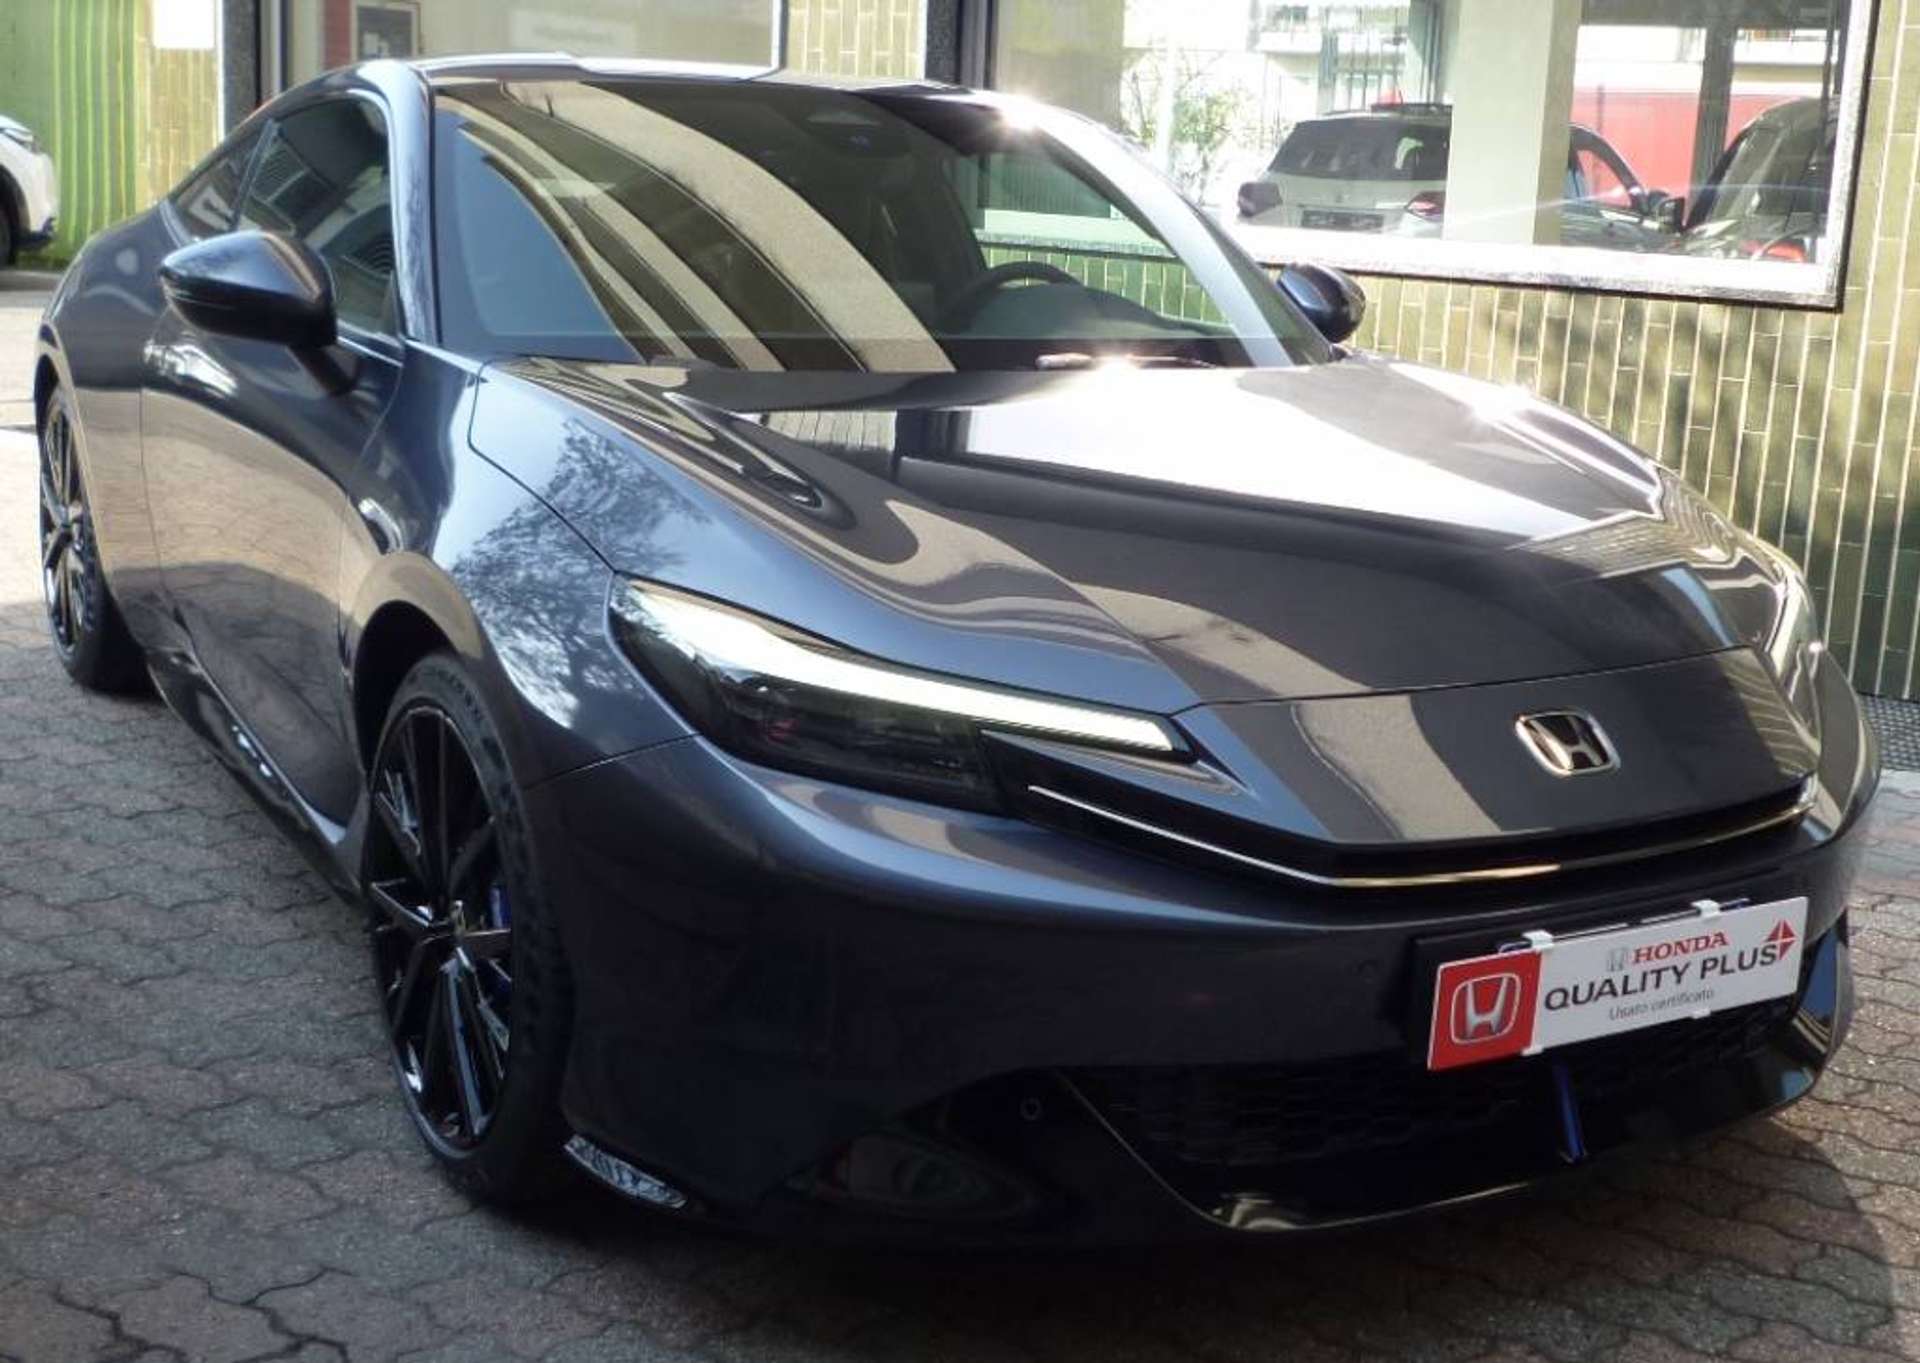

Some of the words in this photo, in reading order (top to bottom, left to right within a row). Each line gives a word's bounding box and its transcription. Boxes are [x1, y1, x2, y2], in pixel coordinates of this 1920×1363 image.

[1632, 931, 1730, 965] HONDA
[1544, 962, 1691, 1011] QUALITY
[1700, 943, 1777, 980] PLUS
[1609, 1002, 1648, 1021] Usato
